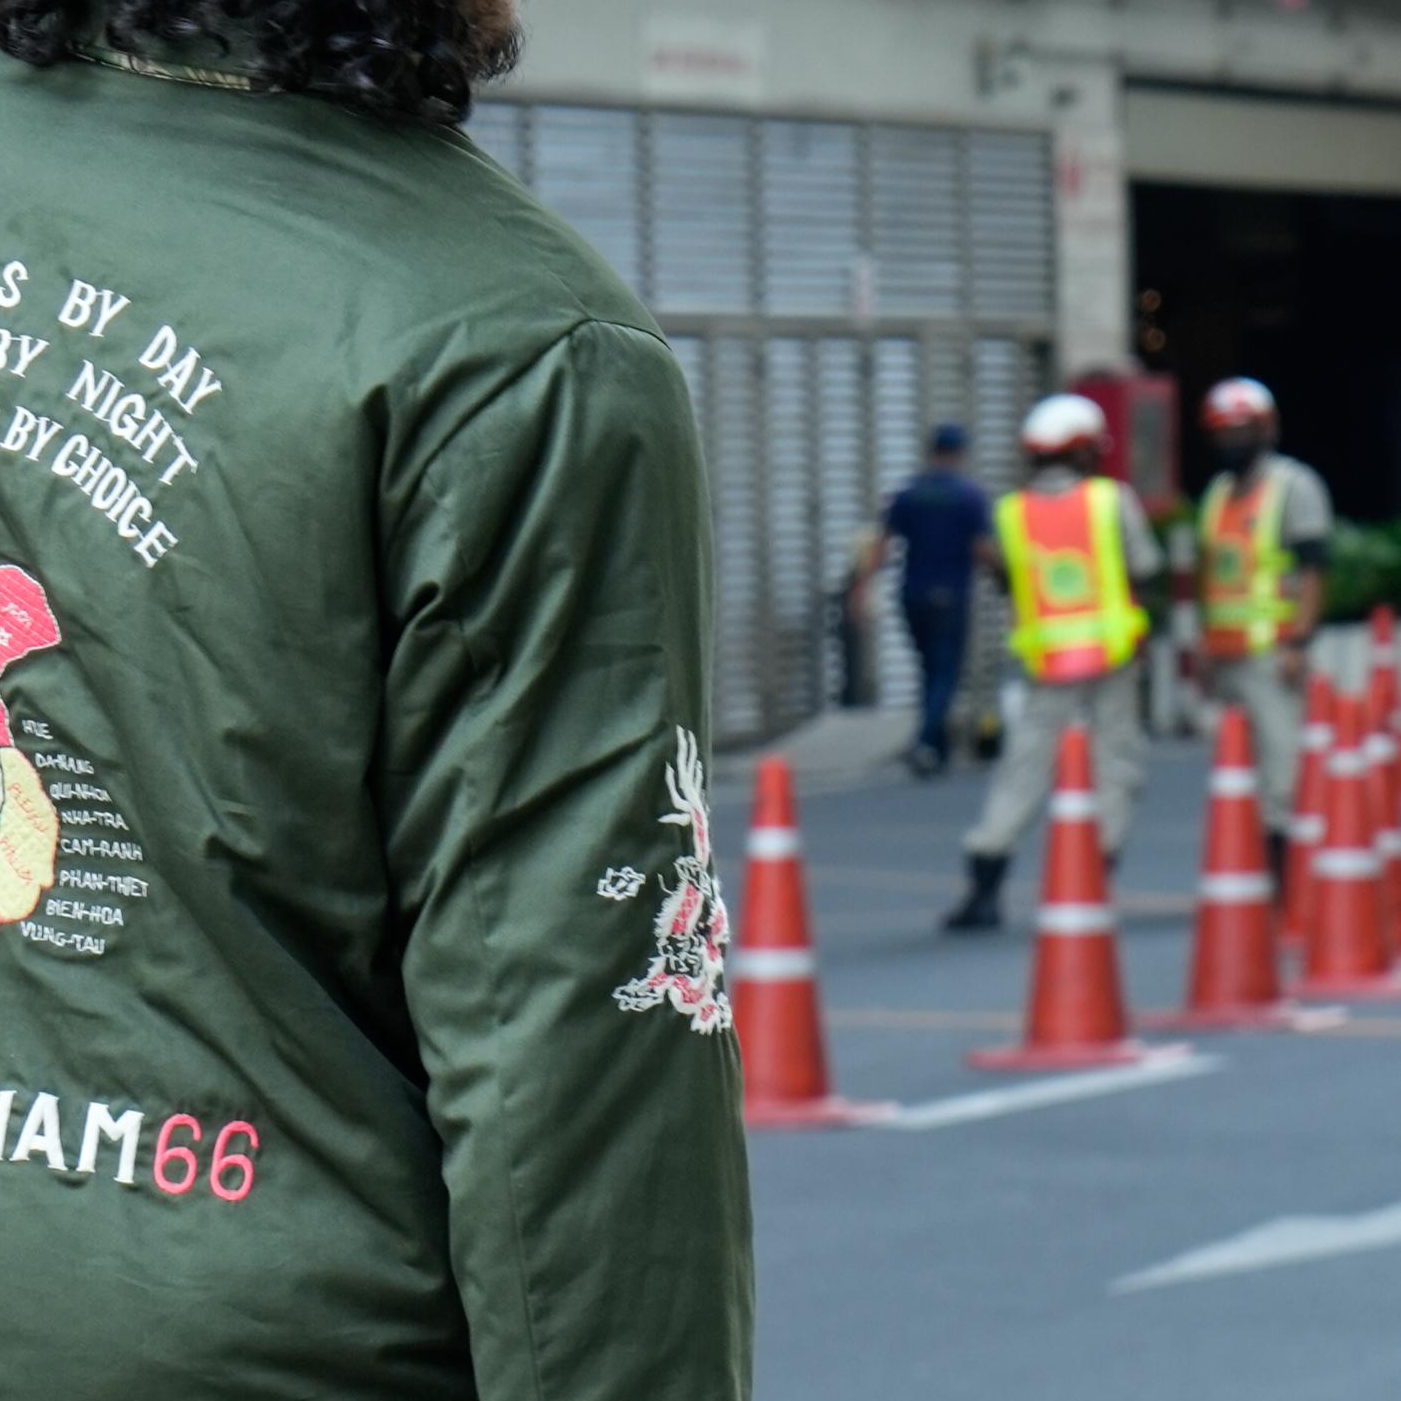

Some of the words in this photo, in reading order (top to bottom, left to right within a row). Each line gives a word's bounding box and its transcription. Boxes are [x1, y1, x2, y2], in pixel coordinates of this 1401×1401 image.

[58, 279, 131, 337] BY
[139, 324, 222, 414] DAY
[66, 359, 198, 486] NIGHT
[0, 406, 63, 461] BY
[51, 434, 178, 568] CHOICE
[60, 838, 144, 861] CAM-RANH
[20, 921, 106, 955] VUNG-TAU
[45, 899, 124, 927] BIEN-HOA
[152, 1113, 260, 1202] 66
